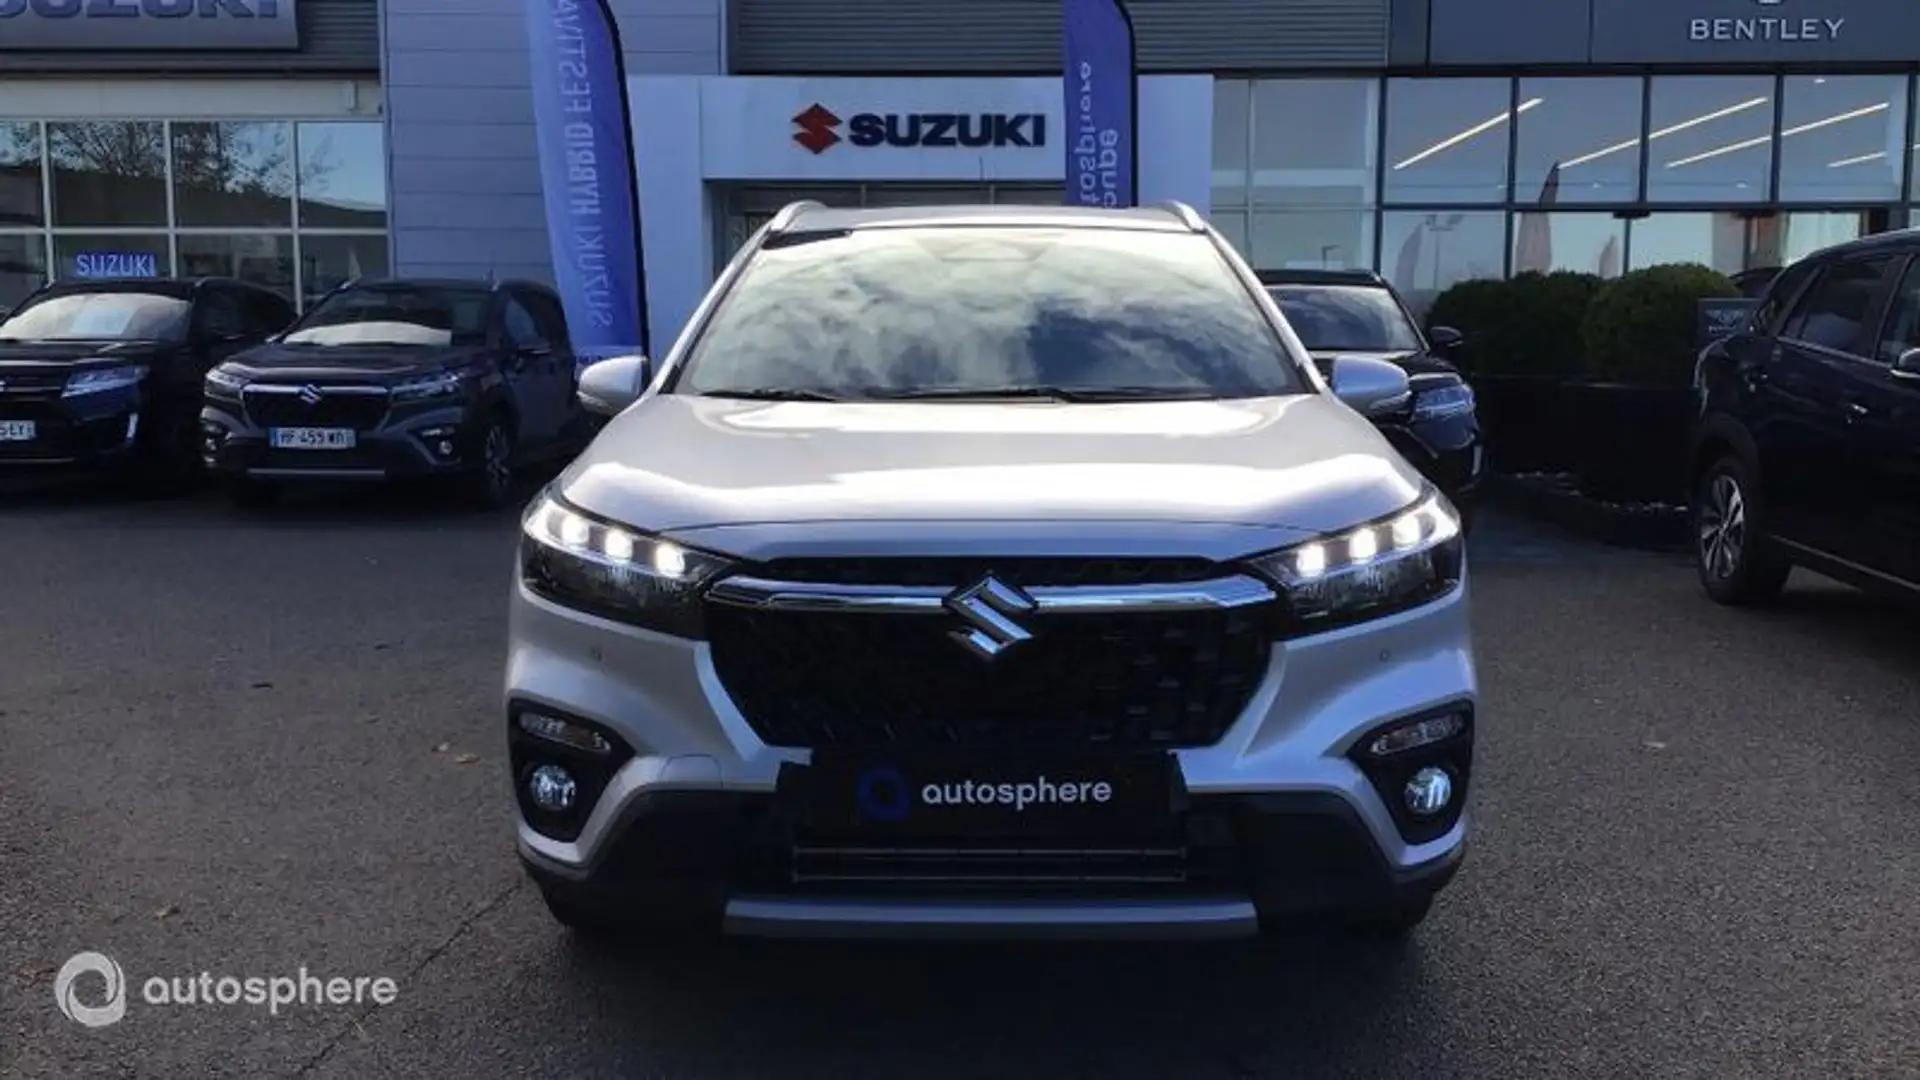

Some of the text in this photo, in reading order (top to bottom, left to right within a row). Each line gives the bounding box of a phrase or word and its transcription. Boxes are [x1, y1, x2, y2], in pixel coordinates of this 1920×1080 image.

[1689, 18, 1845, 40] BENTLEY
[849, 112, 1045, 147] SUZUKI
[76, 253, 156, 277] SUZUKI
[921, 775, 1112, 811] autosphere
